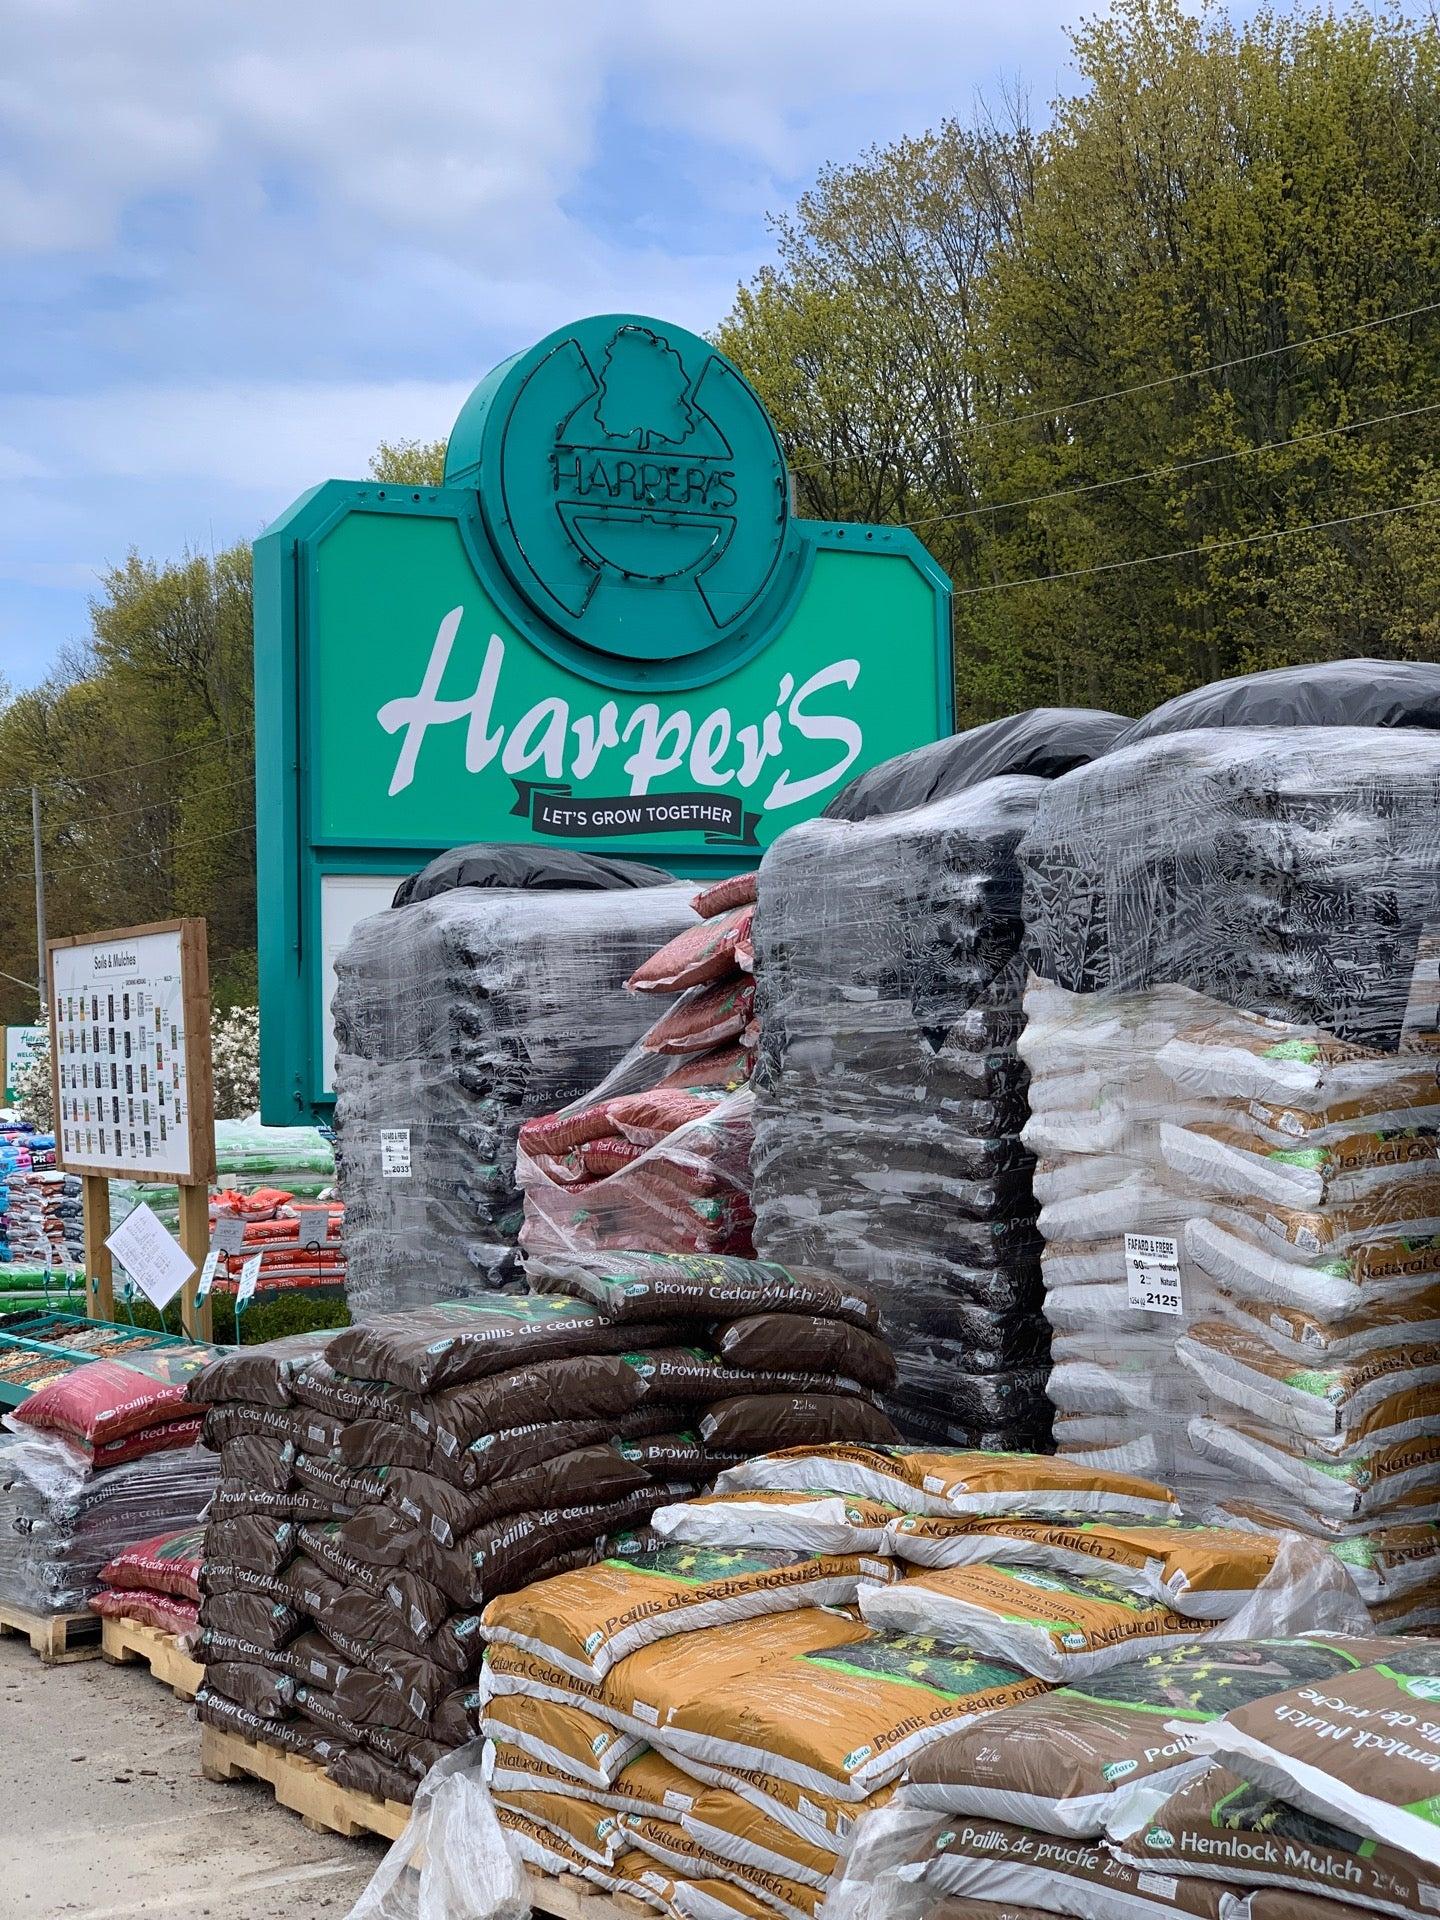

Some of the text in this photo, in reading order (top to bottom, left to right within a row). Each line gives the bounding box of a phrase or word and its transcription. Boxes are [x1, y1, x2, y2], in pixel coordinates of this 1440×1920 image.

[542, 804, 732, 826] LET'S GROW TOGETHER
[94, 954, 107, 970] Soils
[113, 951, 136, 968] Mulches
[392, 1165, 409, 1173] 2033
[654, 1280, 704, 1297] Brown
[708, 1286, 759, 1301] Cedar
[762, 1285, 813, 1302] Mulch
[1146, 1292, 1178, 1307] 2125
[460, 1326, 514, 1345] Paillis
[519, 1322, 543, 1334] de
[546, 1315, 594, 1331] cèdre
[660, 1362, 710, 1378] Brown
[713, 1366, 756, 1380] Cedar
[114, 1394, 154, 1415] Paillis
[157, 1388, 174, 1400] de
[307, 1377, 334, 1397] Brown
[337, 1388, 362, 1406] Cedar
[237, 1406, 262, 1420] Cedar
[263, 1411, 290, 1430] Mulch
[140, 1425, 166, 1441] Red
[648, 1446, 700, 1461] Brown
[1376, 1447, 1440, 1478] Natura
[304, 1459, 332, 1482] Brown
[333, 1474, 361, 1490] Cedar
[249, 1489, 276, 1505] Cedar
[275, 1493, 309, 1508] Mulch
[490, 1519, 535, 1556] Paillis
[539, 1510, 558, 1527] de
[919, 1520, 1103, 1557] Natural Cedar Mulch
[322, 1542, 347, 1567] Cedar
[234, 1566, 261, 1584] Cedar
[260, 1574, 289, 1594] Mulch
[604, 1600, 663, 1634] Paillis
[667, 1591, 691, 1608] de
[755, 1561, 825, 1588] naturel
[212, 1631, 237, 1647] Brown
[238, 1638, 264, 1656] Cedar
[1090, 1617, 1159, 1647] Natural
[528, 1664, 606, 1701] Cedar Mulch
[207, 1695, 237, 1717] Brown
[237, 1708, 263, 1728] Cedar
[263, 1716, 296, 1742] Mulch
[307, 1695, 335, 1722] Brown
[336, 1714, 362, 1738] Cedar
[872, 1715, 925, 1751] Paillis
[929, 1705, 953, 1723] de
[956, 1690, 1009, 1714] cèdre
[1274, 1705, 1353, 1740] Mulch
[1380, 1709, 1417, 1728] de
[499, 1750, 545, 1775] Natural
[1104, 1760, 1138, 1781] Fafard
[641, 1821, 696, 1853] Natural
[961, 1827, 1100, 1871] Paillis de pruche
[1145, 1831, 1363, 1884] Fafard Hemlock Mulch
